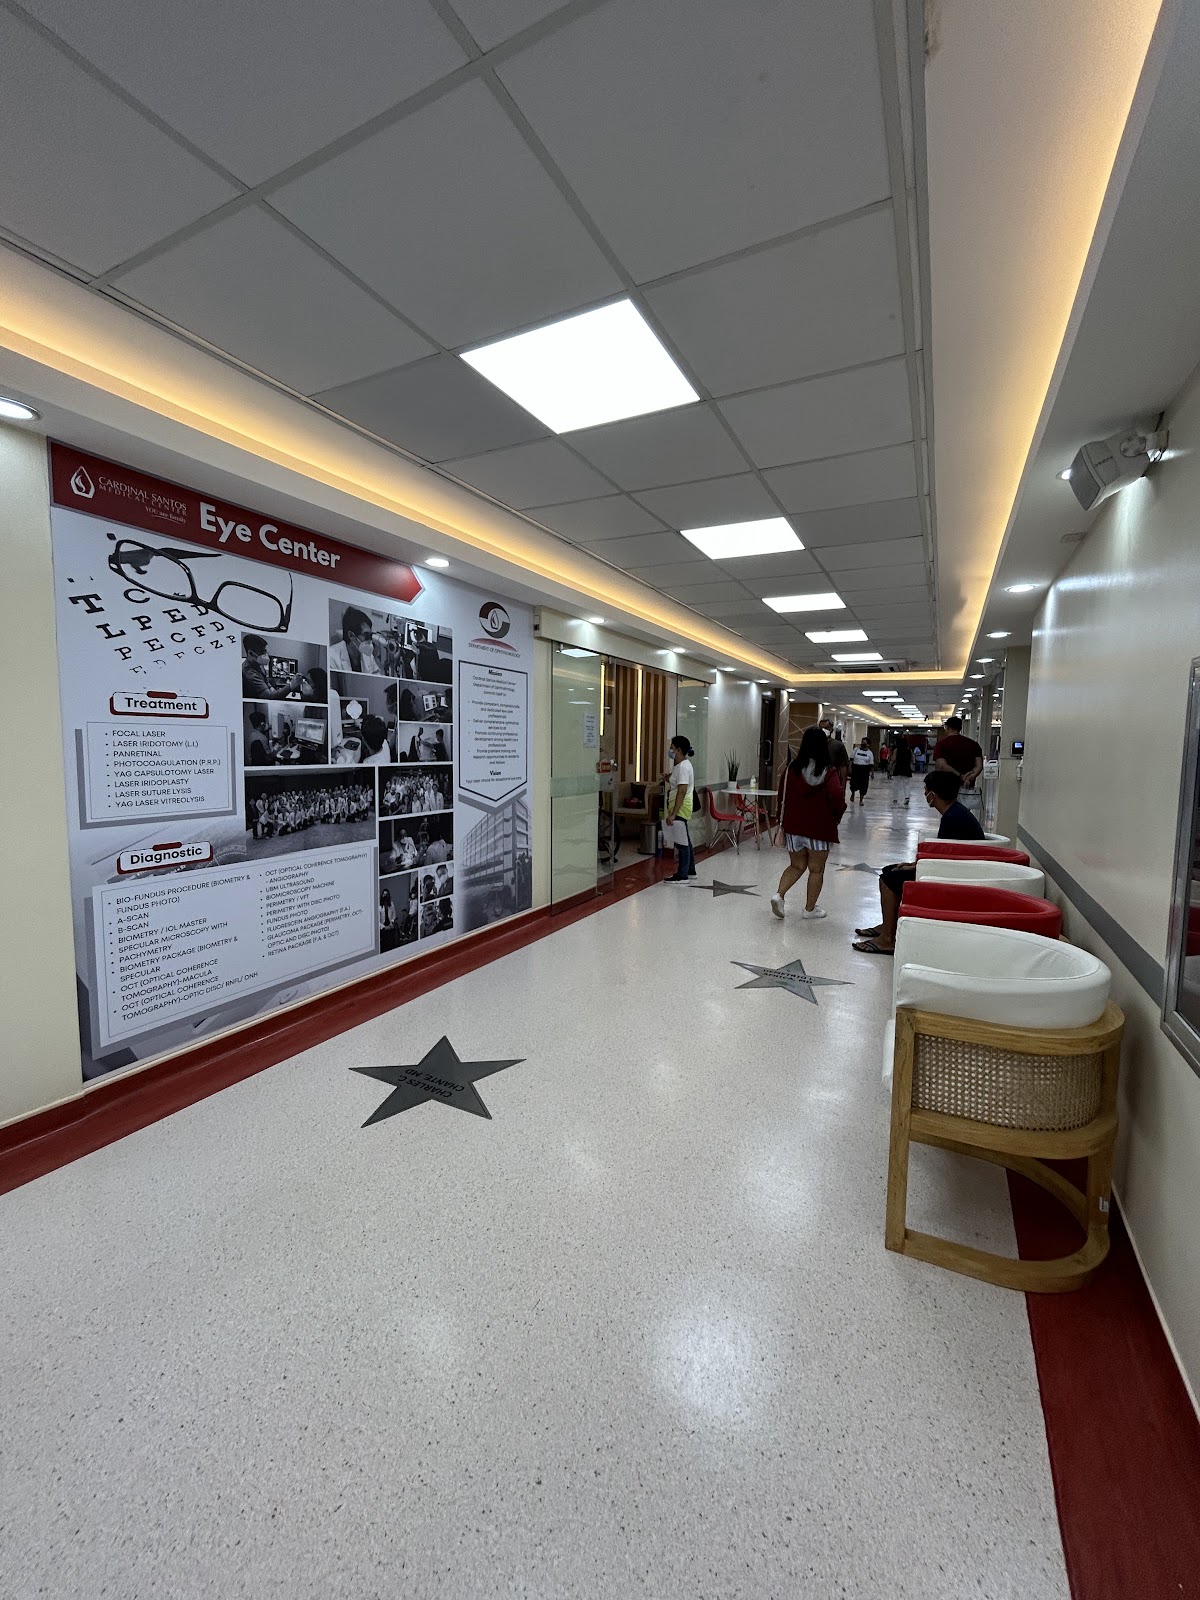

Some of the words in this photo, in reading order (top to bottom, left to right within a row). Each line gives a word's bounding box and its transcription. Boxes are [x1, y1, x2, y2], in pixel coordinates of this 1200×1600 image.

[98, 476, 149, 500] CARDINAL
[152, 494, 186, 510] SANTOS
[99, 484, 145, 503] MEDICAL
[152, 500, 186, 516] CENTER
[145, 506, 158, 514] YOU
[170, 512, 186, 524] family
[200, 502, 252, 543] Eye
[259, 524, 340, 568] Center
[68, 594, 105, 614] T
[95, 623, 126, 639] L
[162, 608, 188, 623] E
[114, 646, 132, 660] P
[143, 638, 165, 652] E
[170, 633, 185, 642] C
[210, 621, 224, 631] D
[210, 640, 223, 649] Z
[226, 635, 236, 643] P
[125, 698, 197, 711] Treatment
[161, 796, 205, 804] VITREOLYSIS
[130, 846, 202, 865] Diagnostic
[279, 865, 302, 874] (OPTICAL
[304, 859, 333, 869] COHERENCE
[334, 853, 367, 863] TOMOGRAPHY)
[270, 871, 308, 884] ANGIOGRAPHY
[280, 878, 314, 889] ULTRASOUND
[116, 890, 166, 905] BIO-FUNDUS
[167, 883, 210, 895] PROCEDURE
[211, 875, 245, 888] (BIOMETRY
[266, 886, 311, 900] BIOMICROSCOPY
[312, 880, 335, 889] MACHINE
[116, 902, 149, 914] FUNDUS
[151, 896, 180, 906] PHOTO)
[266, 898, 295, 908] PERIMETRY
[267, 905, 295, 916] PERIMETRY
[117, 912, 149, 924] A-SCAN
[267, 915, 289, 924] FUNDUS
[290, 910, 308, 918] PHOTO
[267, 919, 302, 932] FLUORESCEIN
[304, 909, 339, 922] ANGIOGRAPHY
[118, 922, 149, 934] B-SCAN
[118, 929, 159, 943] BIOMETRY
[180, 918, 207, 930] MASTER
[119, 939, 159, 953] SPECULAR
[161, 926, 210, 943] MICROSCOPY
[211, 922, 228, 930] WITH
[267, 928, 299, 940] GLAUCOMA
[300, 920, 323, 930] PACKAGE
[268, 940, 284, 948] OPTIC
[311, 926, 329, 935] PHOTO)
[119, 944, 173, 962] PACHYMETRY
[120, 957, 160, 972] BIOMETRY
[162, 948, 195, 961] PACKAGE
[198, 937, 232, 952] (BIOMETRY
[268, 947, 286, 956] RETINA
[288, 939, 311, 950] PACKAGE
[121, 966, 160, 982] SPECULAR
[121, 982, 138, 992] OCT
[140, 971, 175, 987] (OPTICAL
[176, 958, 218, 975] COHERENCE
[122, 970, 212, 1002] TOMOGRAPHY)-MACULA
[122, 1001, 139, 1011] OCT
[141, 990, 175, 1006] (OPTICAL
[177, 976, 219, 993] COHERENCE
[122, 990, 204, 1020] TOMOGRAPHY)-OPTIC
[206, 982, 224, 993] DISC/
[244, 972, 258, 980] ONH
[405, 1069, 422, 1077] MD
[406, 1079, 452, 1098] CHARLES
[423, 1074, 465, 1092] CHANTE
